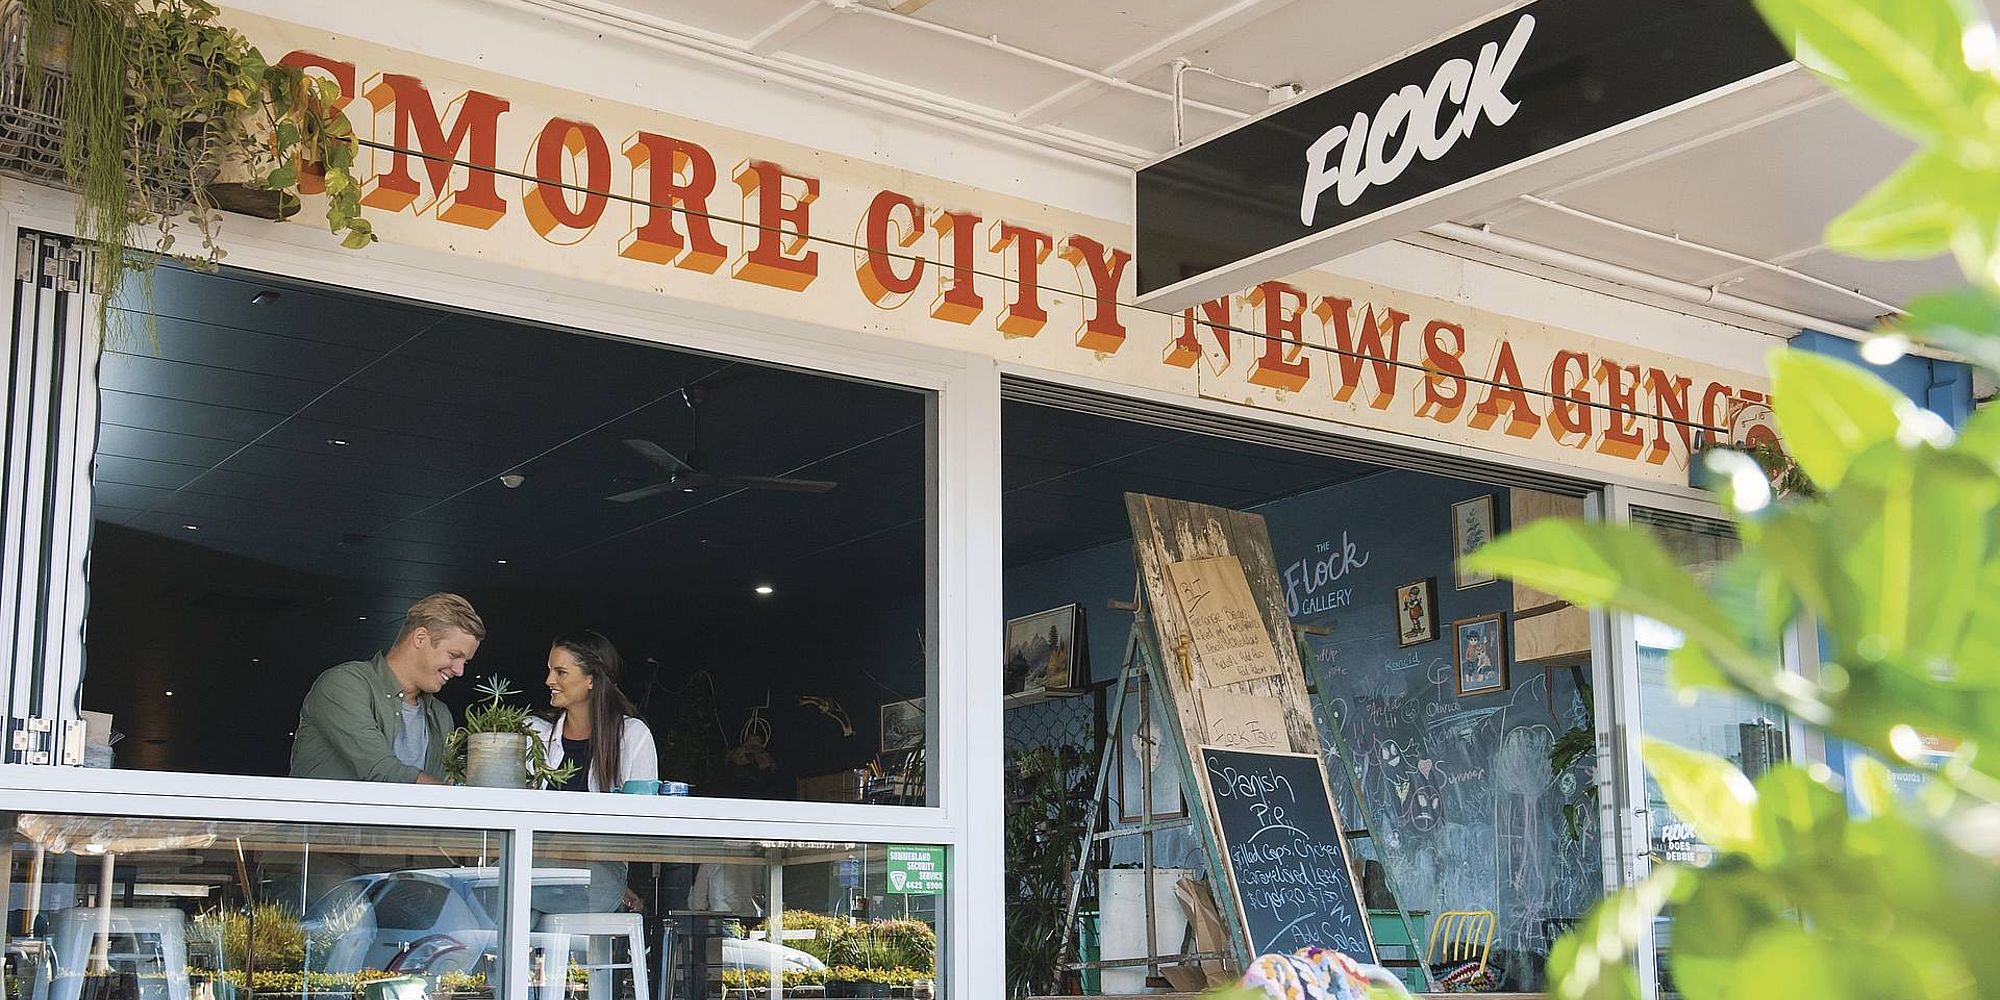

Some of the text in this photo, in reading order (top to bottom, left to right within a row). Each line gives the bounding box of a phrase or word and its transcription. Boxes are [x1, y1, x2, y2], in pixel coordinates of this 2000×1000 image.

[1300, 13, 1536, 227] FLOCK
[855, 189, 1132, 353] CITY
[1162, 281, 1772, 474] NEWSAGENC
[1316, 541, 1330, 552] THE
[1283, 530, 1369, 617] Flock
[1302, 588, 1352, 615] GALLERY
[1668, 841, 1690, 851] DOES
[890, 851, 931, 862] SUMMERLAND
[1666, 851, 1695, 861] DEBBIE
[906, 861, 935, 871] SECURITY
[919, 872, 944, 881] SERVICE
